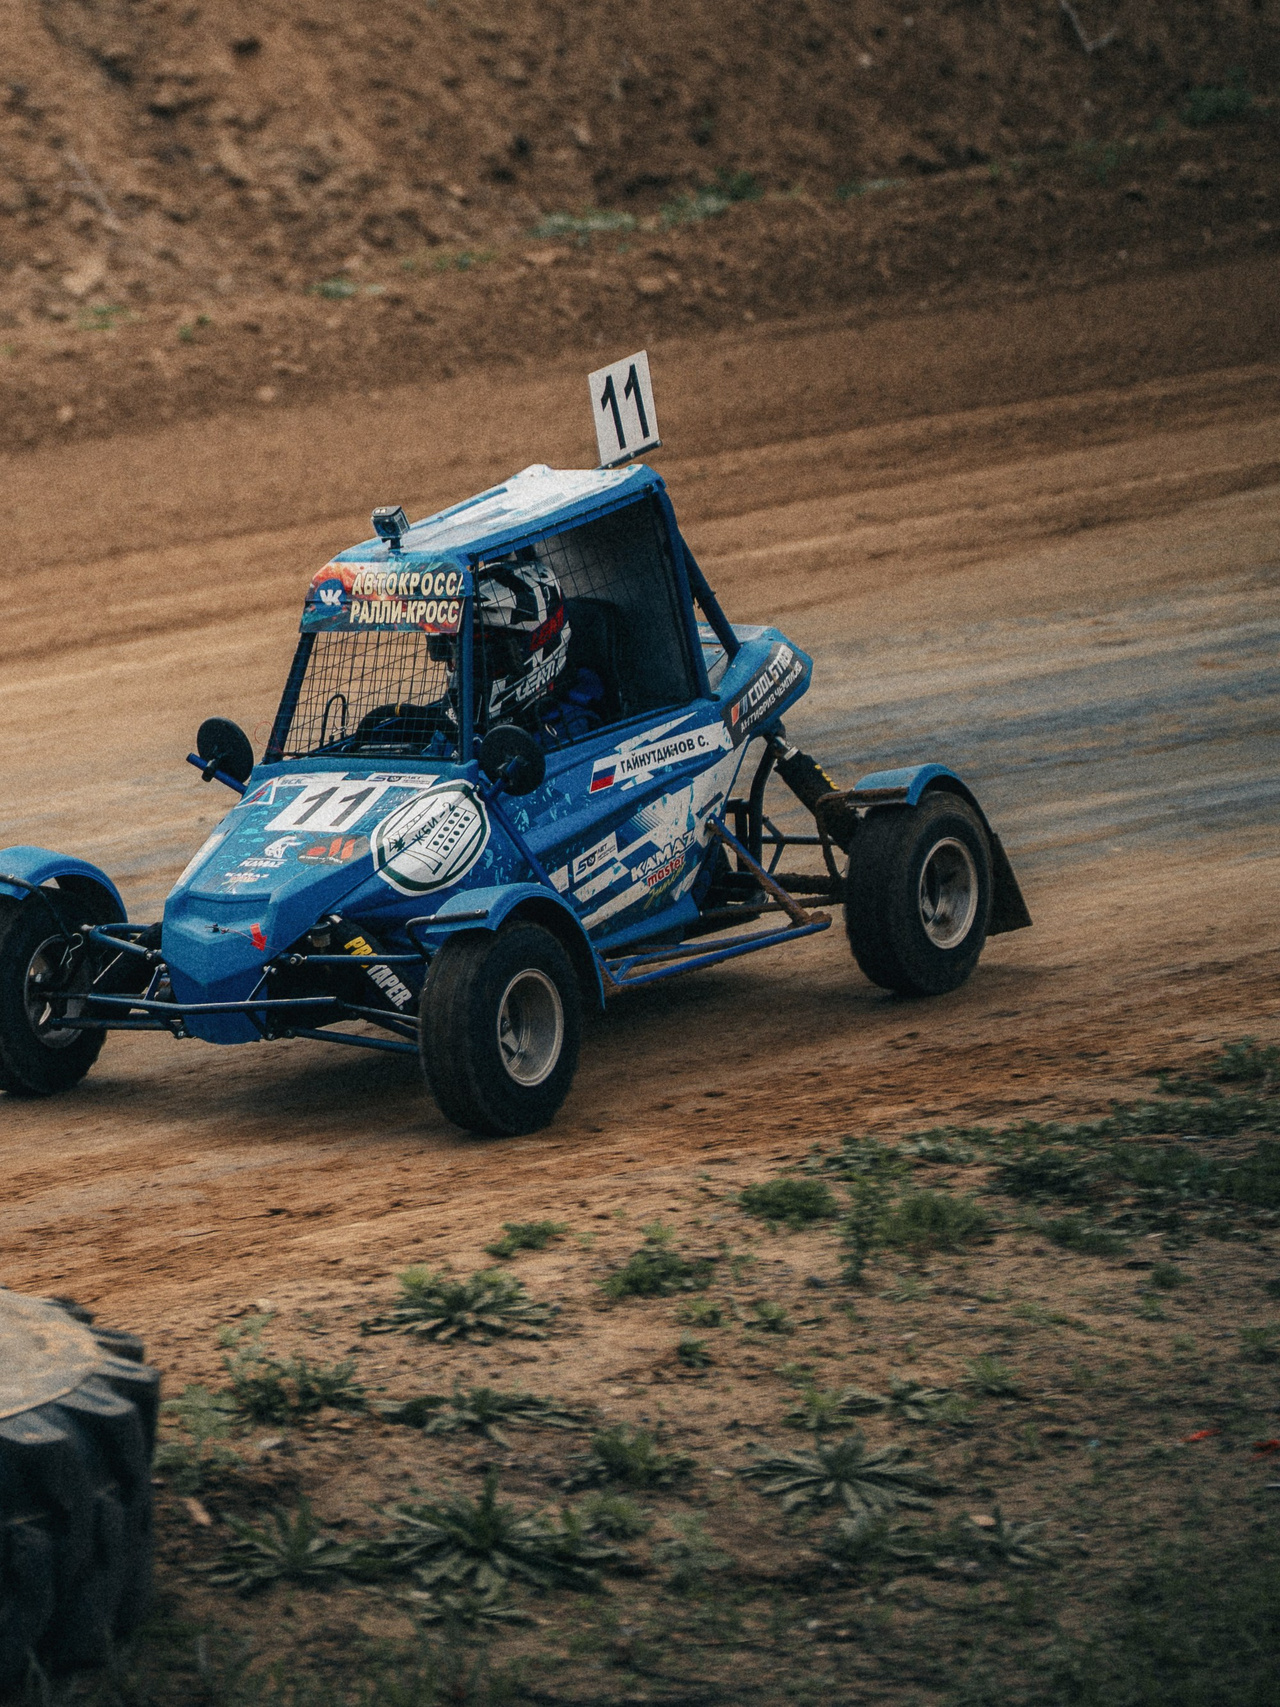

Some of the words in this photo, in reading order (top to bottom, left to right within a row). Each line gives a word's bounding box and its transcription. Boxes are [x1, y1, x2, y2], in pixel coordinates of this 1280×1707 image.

[600, 363, 650, 450] 11
[351, 572, 458, 597] АВТОКРОСС
[349, 600, 459, 624] РАЛЛИ-КРОСС
[620, 738, 696, 774] ГАЙНУТДИНОВ
[292, 787, 376, 826] 11
[647, 853, 686, 888] master
